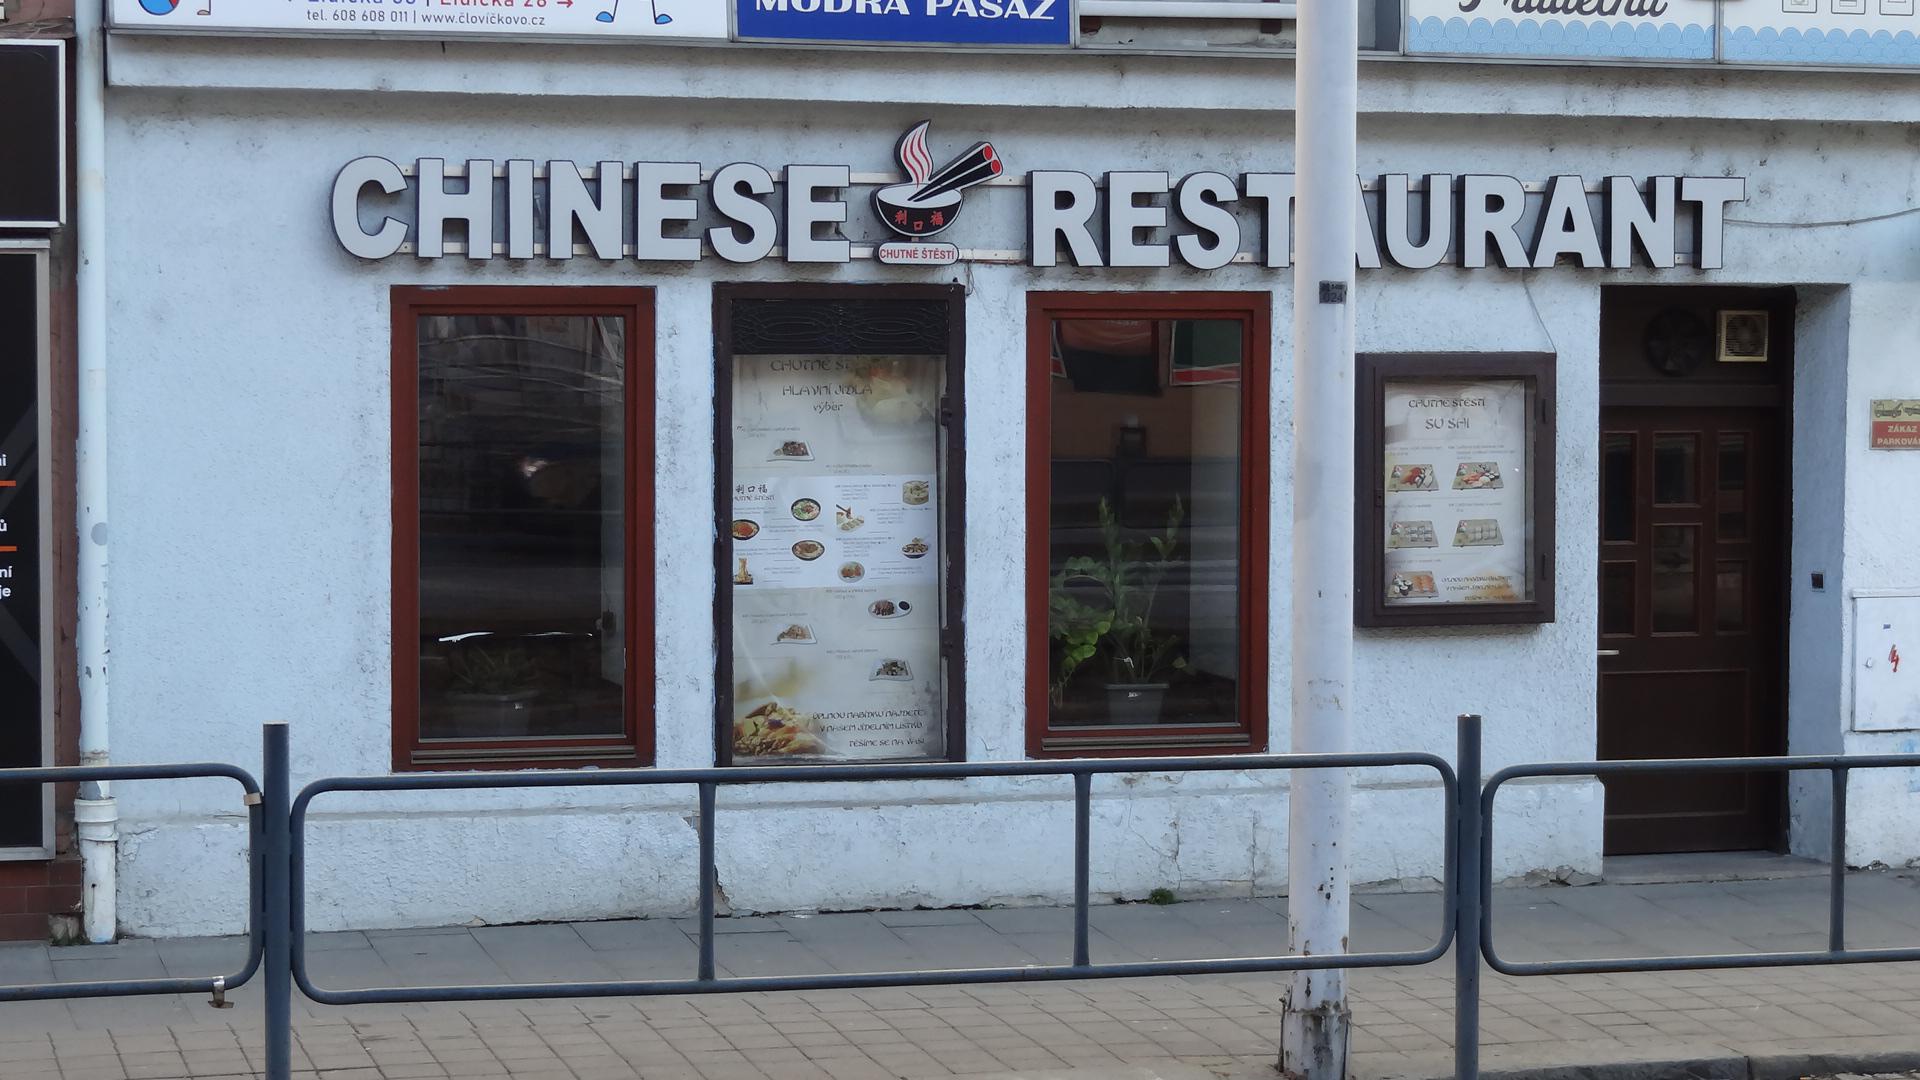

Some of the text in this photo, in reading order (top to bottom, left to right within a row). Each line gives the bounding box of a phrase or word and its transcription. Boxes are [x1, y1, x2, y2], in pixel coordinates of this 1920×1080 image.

[307, 9, 328, 21] tel.
[332, 9, 356, 21] 608
[361, 10, 385, 22] 608
[390, 10, 408, 23] 011
[331, 155, 851, 264] CHINESE
[879, 247, 955, 260] CHUTNÉ ŠTĚSTÍ
[1877, 437, 1920, 445] PARKOVÁ
